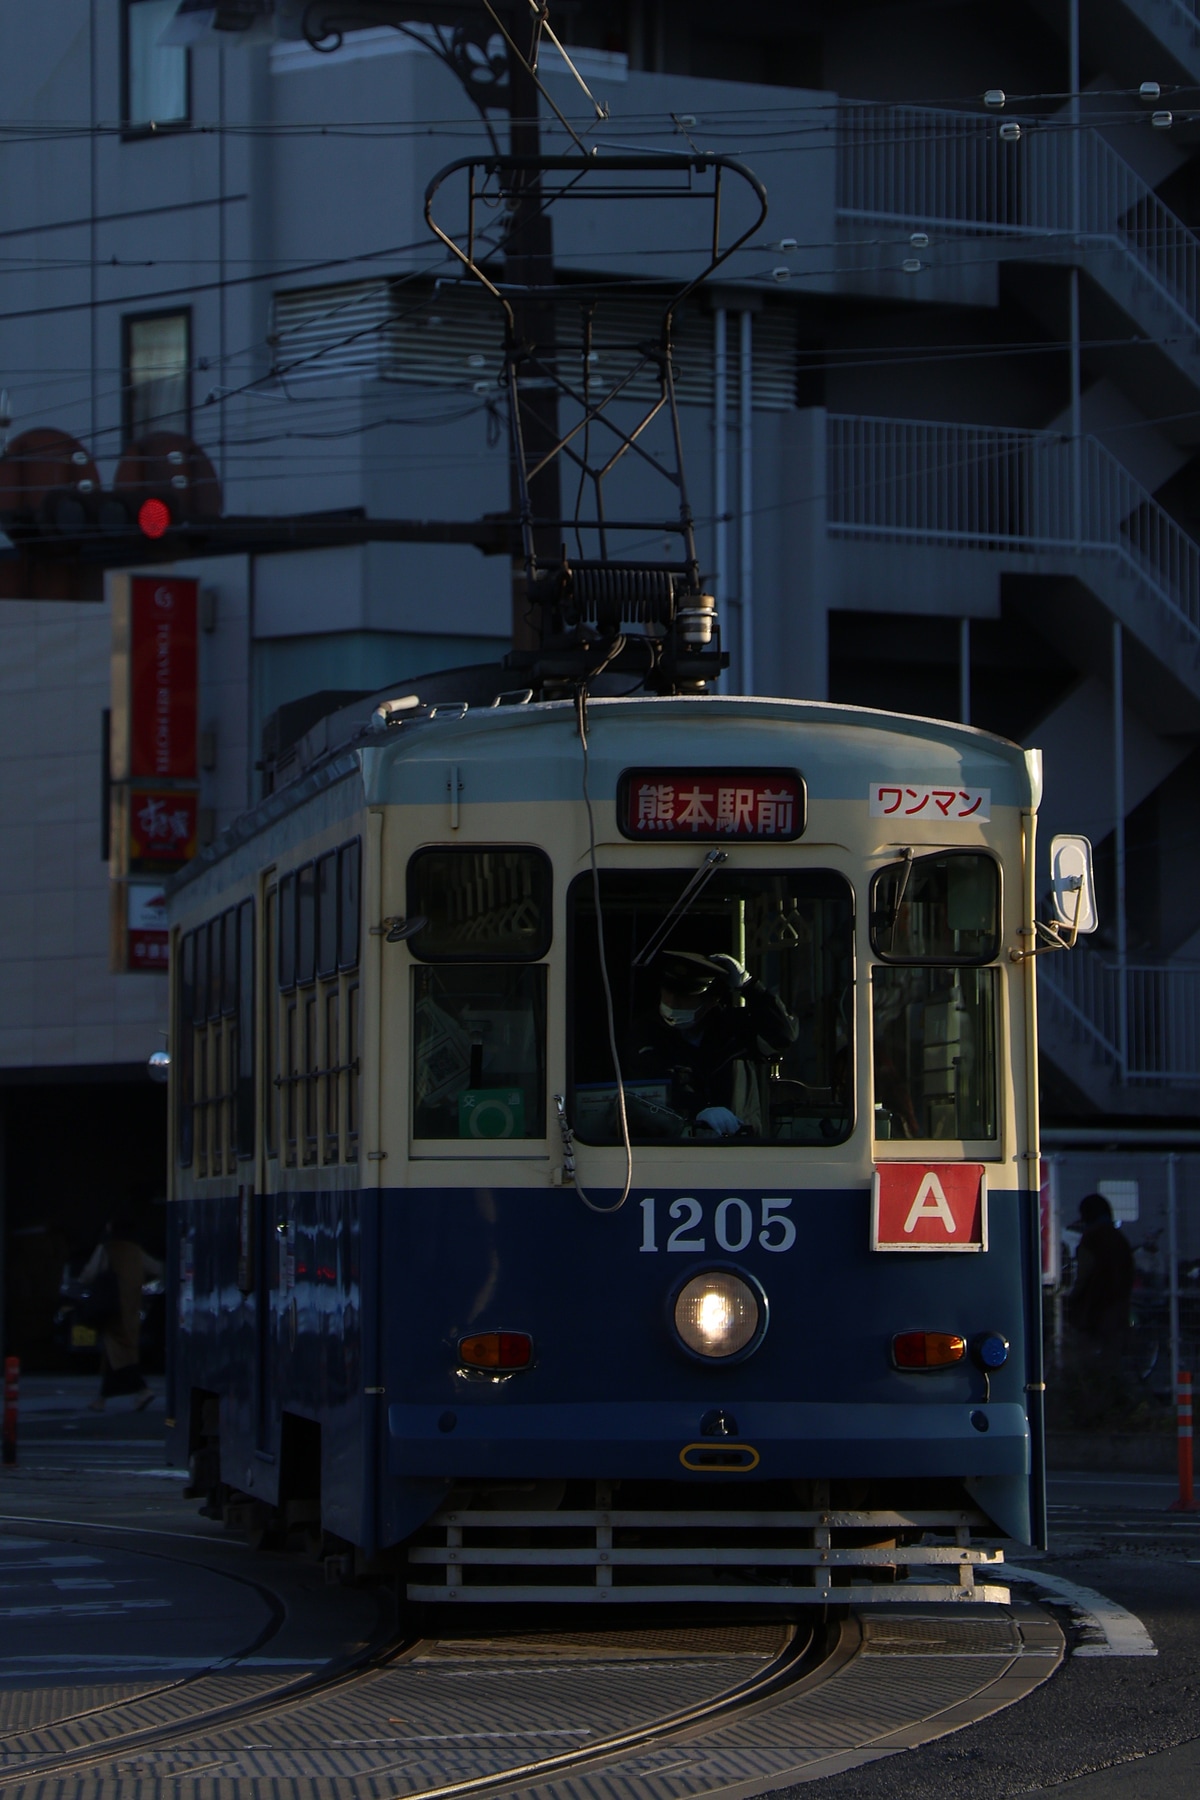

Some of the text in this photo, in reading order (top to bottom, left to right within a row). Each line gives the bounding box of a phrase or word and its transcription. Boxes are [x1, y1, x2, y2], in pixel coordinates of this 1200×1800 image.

[636, 784, 795, 834] 熊本駅前
[878, 788, 982, 817] ワンマン
[638, 1197, 796, 1253] 1205
[903, 1171, 956, 1233] A
